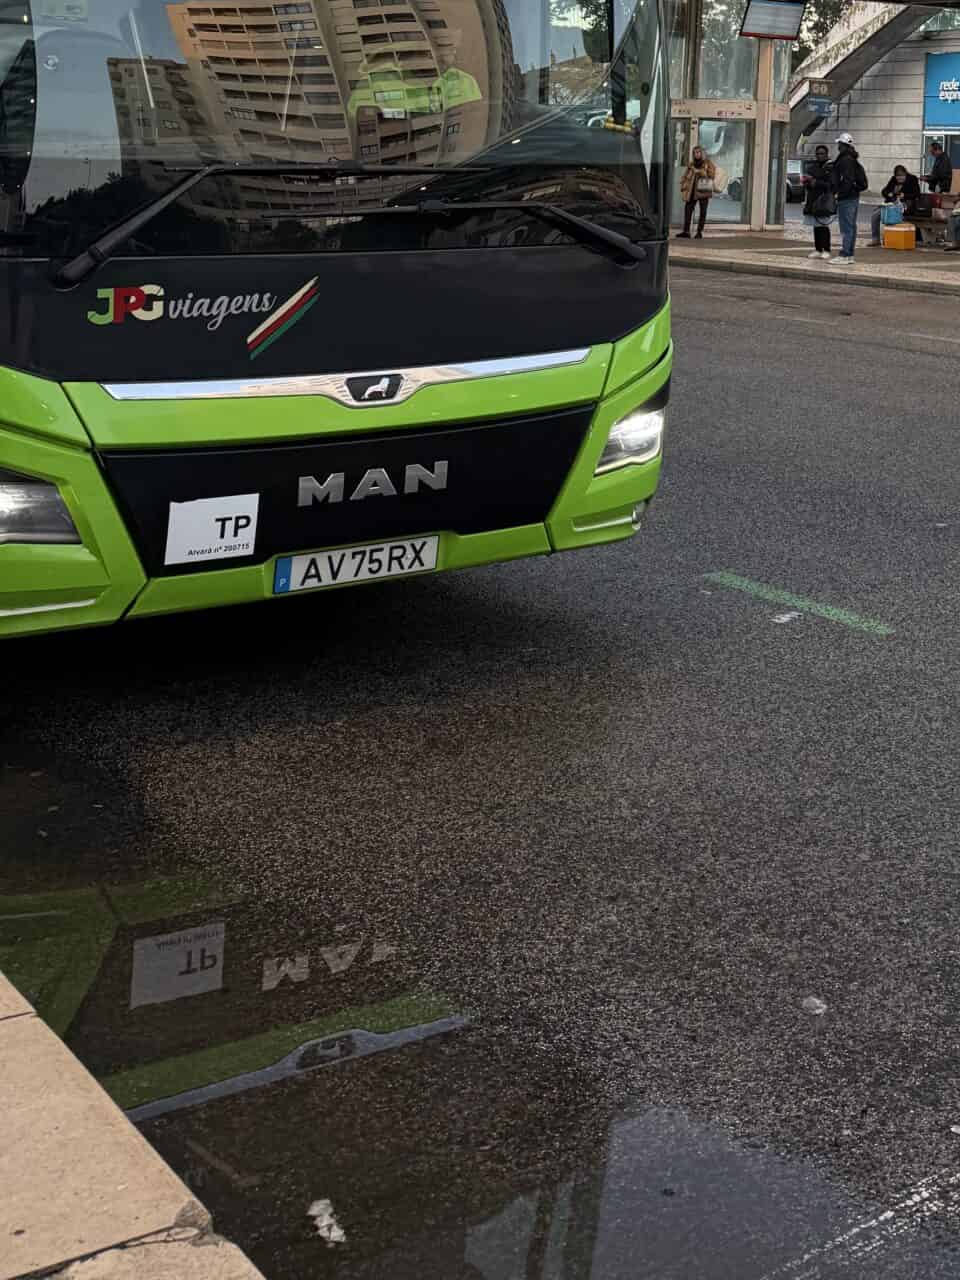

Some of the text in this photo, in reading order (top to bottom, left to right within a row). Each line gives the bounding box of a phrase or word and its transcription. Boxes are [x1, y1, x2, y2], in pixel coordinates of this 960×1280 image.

[939, 77, 960, 90] rede
[87, 284, 277, 331] JPG viagens
[297, 460, 448, 507] MAN
[215, 515, 251, 539] TP
